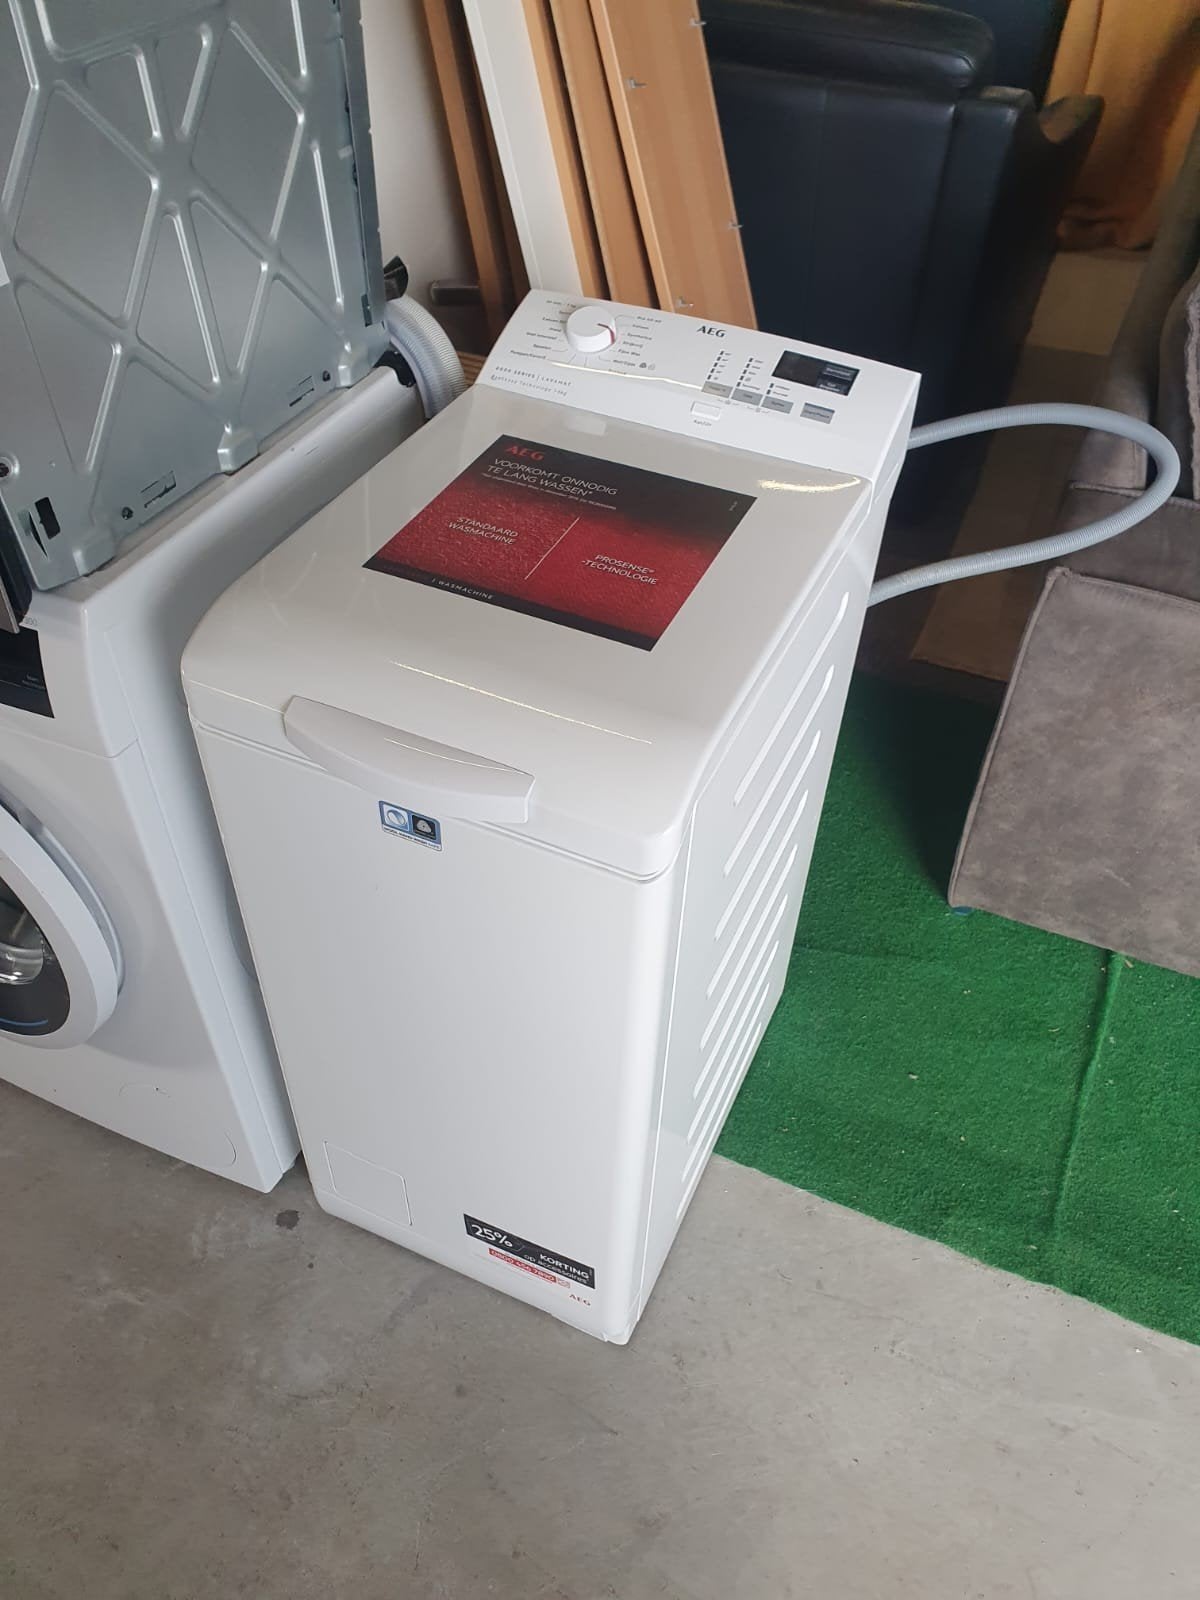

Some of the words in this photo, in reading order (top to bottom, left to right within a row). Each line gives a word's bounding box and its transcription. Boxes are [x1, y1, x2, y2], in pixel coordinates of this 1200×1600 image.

[697, 325, 726, 338] AEG
[504, 444, 545, 461] AEG
[487, 465, 503, 475] TE
[504, 470, 537, 484] LANG
[494, 458, 560, 480] VOORKOMT
[561, 475, 618, 496] ONNODIG
[448, 521, 517, 545] WASMACHINE
[456, 516, 519, 538] STANDAARD
[438, 580, 494, 600] WASMACHINE
[471, 1223, 513, 1248] 25%
[539, 1253, 590, 1280] KORTING
[569, 1293, 592, 1307] AEG
